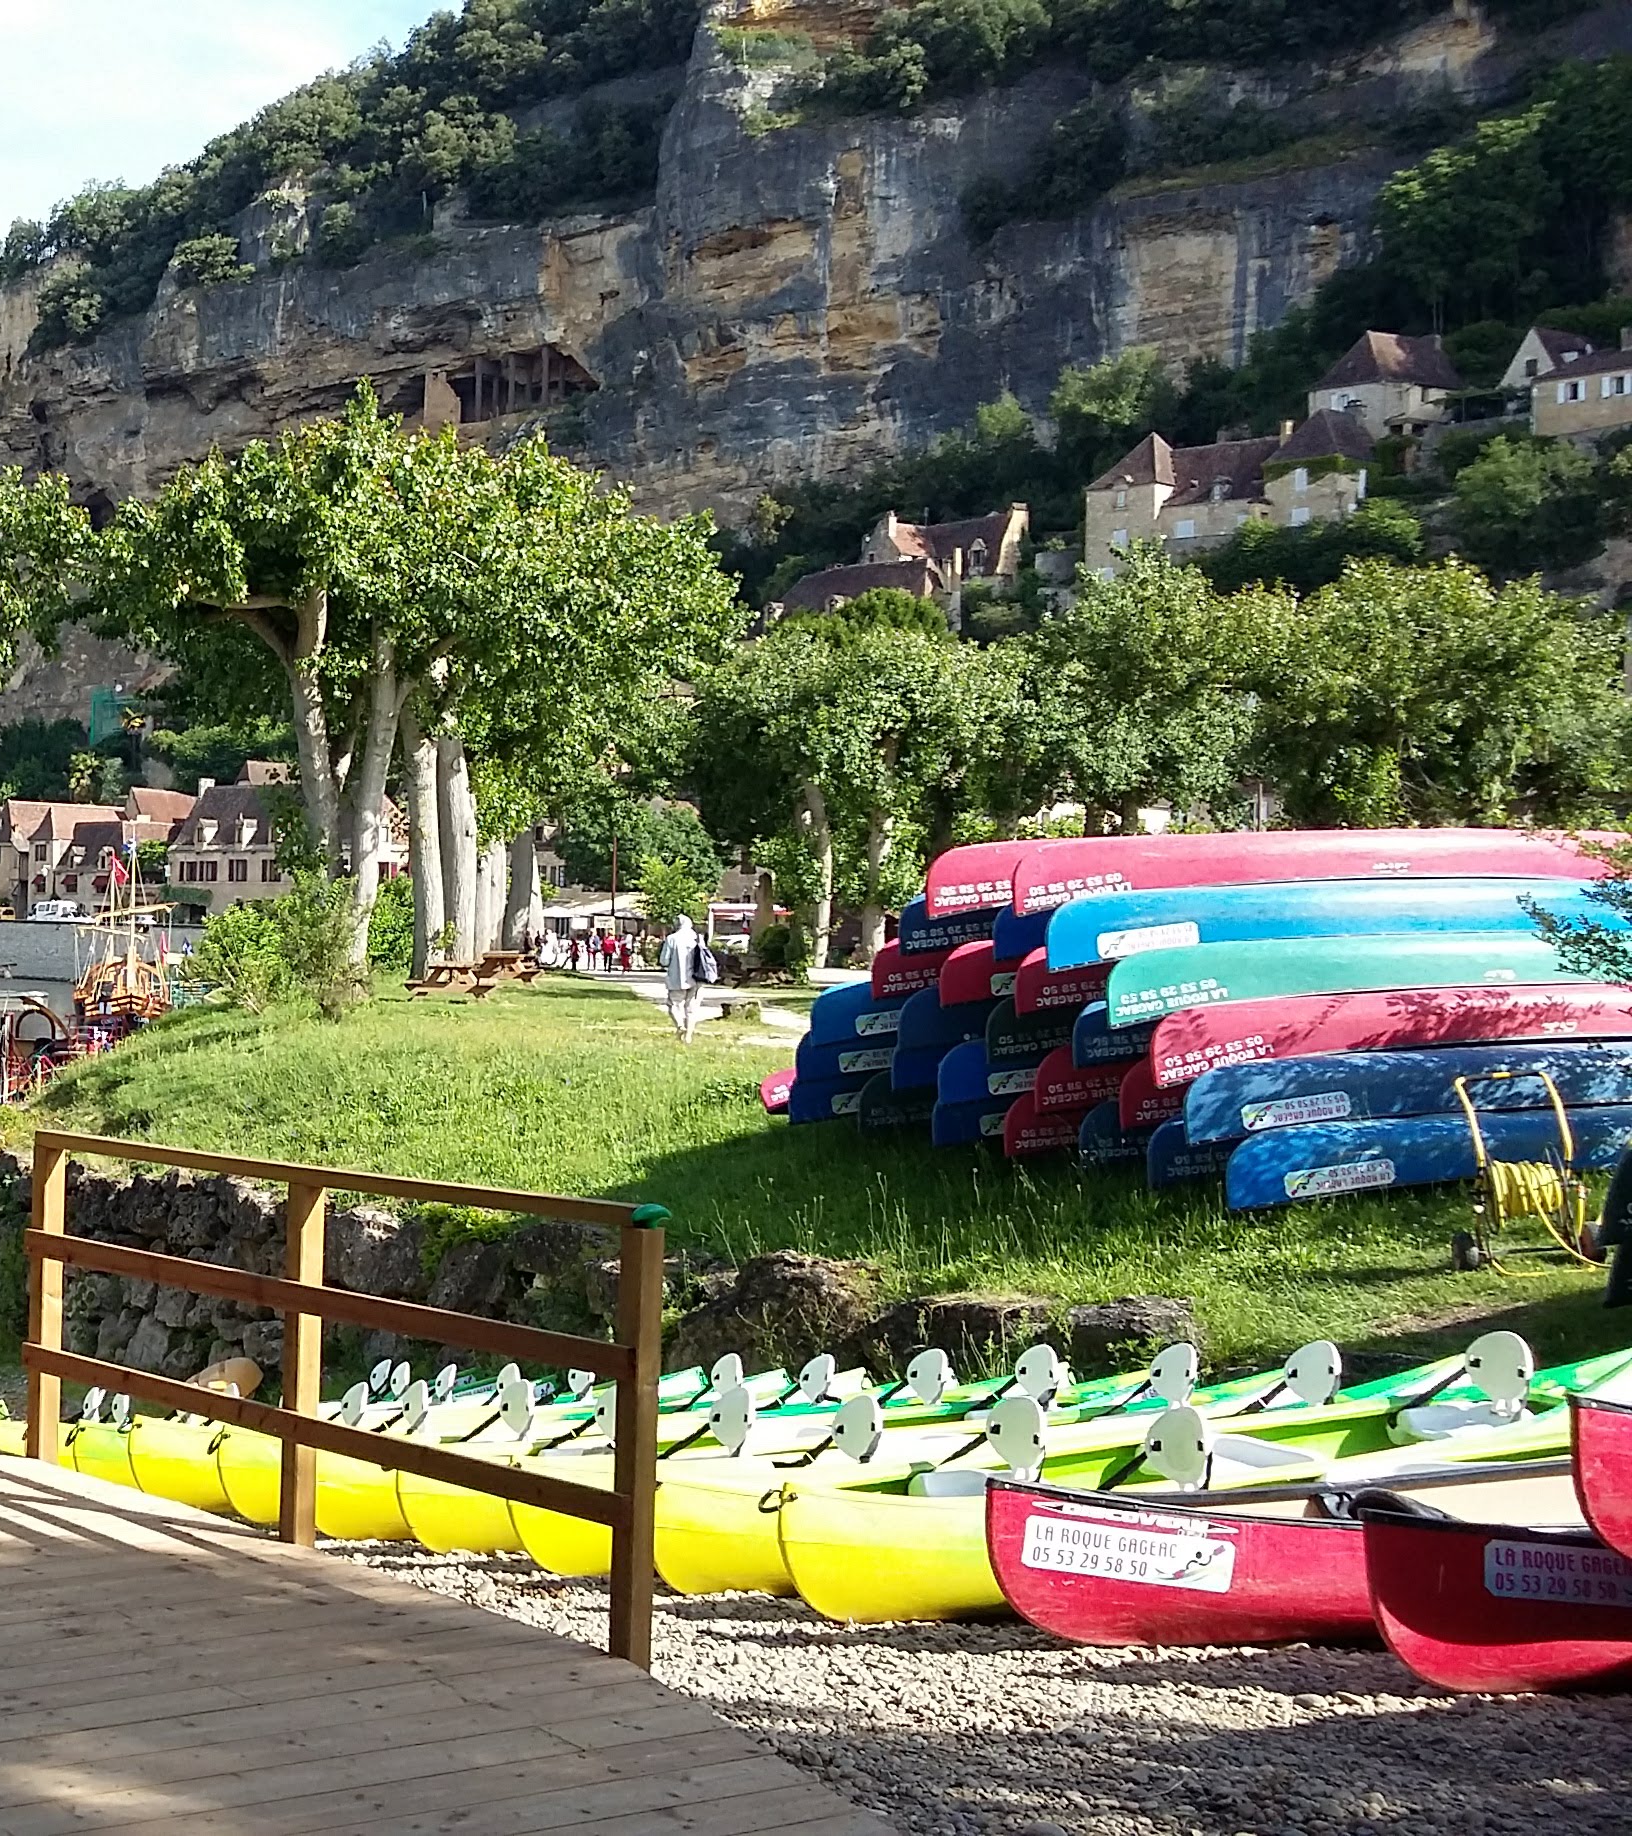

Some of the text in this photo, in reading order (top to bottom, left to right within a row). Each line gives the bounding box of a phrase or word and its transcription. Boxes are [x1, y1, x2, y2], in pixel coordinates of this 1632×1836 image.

[1160, 1043, 1275, 1081] LA ROQUE GAGEAC
[1165, 1035, 1263, 1067] 05 53 29 58 50
[1035, 1523, 1178, 1559] LA ROQUE GAGEAC
[1032, 1546, 1148, 1577] 05 53 29 58 50
[1495, 1547, 1516, 1567] LA
[1522, 1550, 1576, 1573] ROQUE
[1495, 1572, 1515, 1591] 05
[1522, 1575, 1541, 1593] 53
[1547, 1576, 1567, 1595] 29
